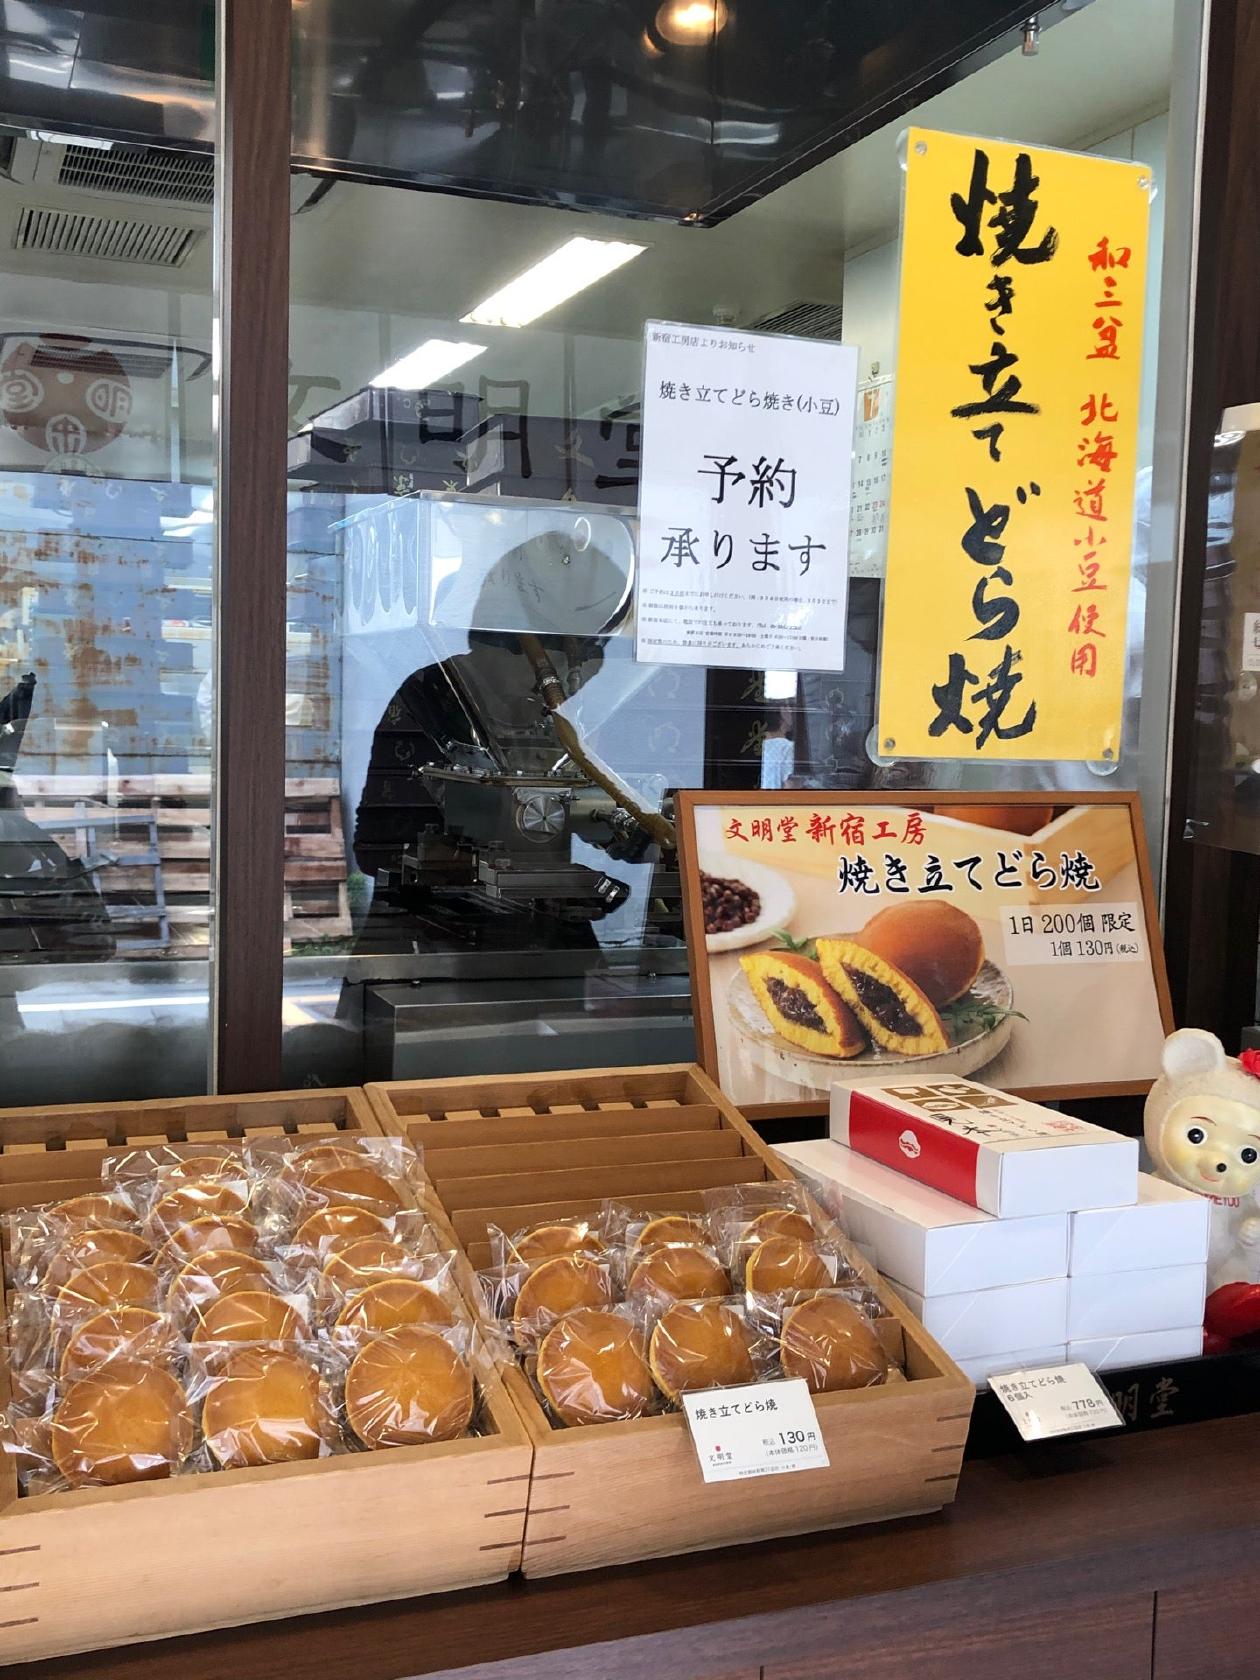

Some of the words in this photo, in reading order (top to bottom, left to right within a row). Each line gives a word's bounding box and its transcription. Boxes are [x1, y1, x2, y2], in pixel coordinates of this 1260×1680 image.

[1086, 236, 1132, 361] 和三盆
[651, 329, 757, 354] 新宿工房店よりお知らせ
[658, 379, 842, 418] 焼き立てどら焼き(小豆)
[928, 148, 1060, 751] 焼き立てどら焼
[696, 453, 798, 510] 予約
[660, 525, 827, 577] 承ります
[1067, 391, 1120, 679] 北海道小豆使用
[837, 850, 1102, 895] 焼き立てどら焼
[694, 1398, 779, 1421] 焼き立てどら焼
